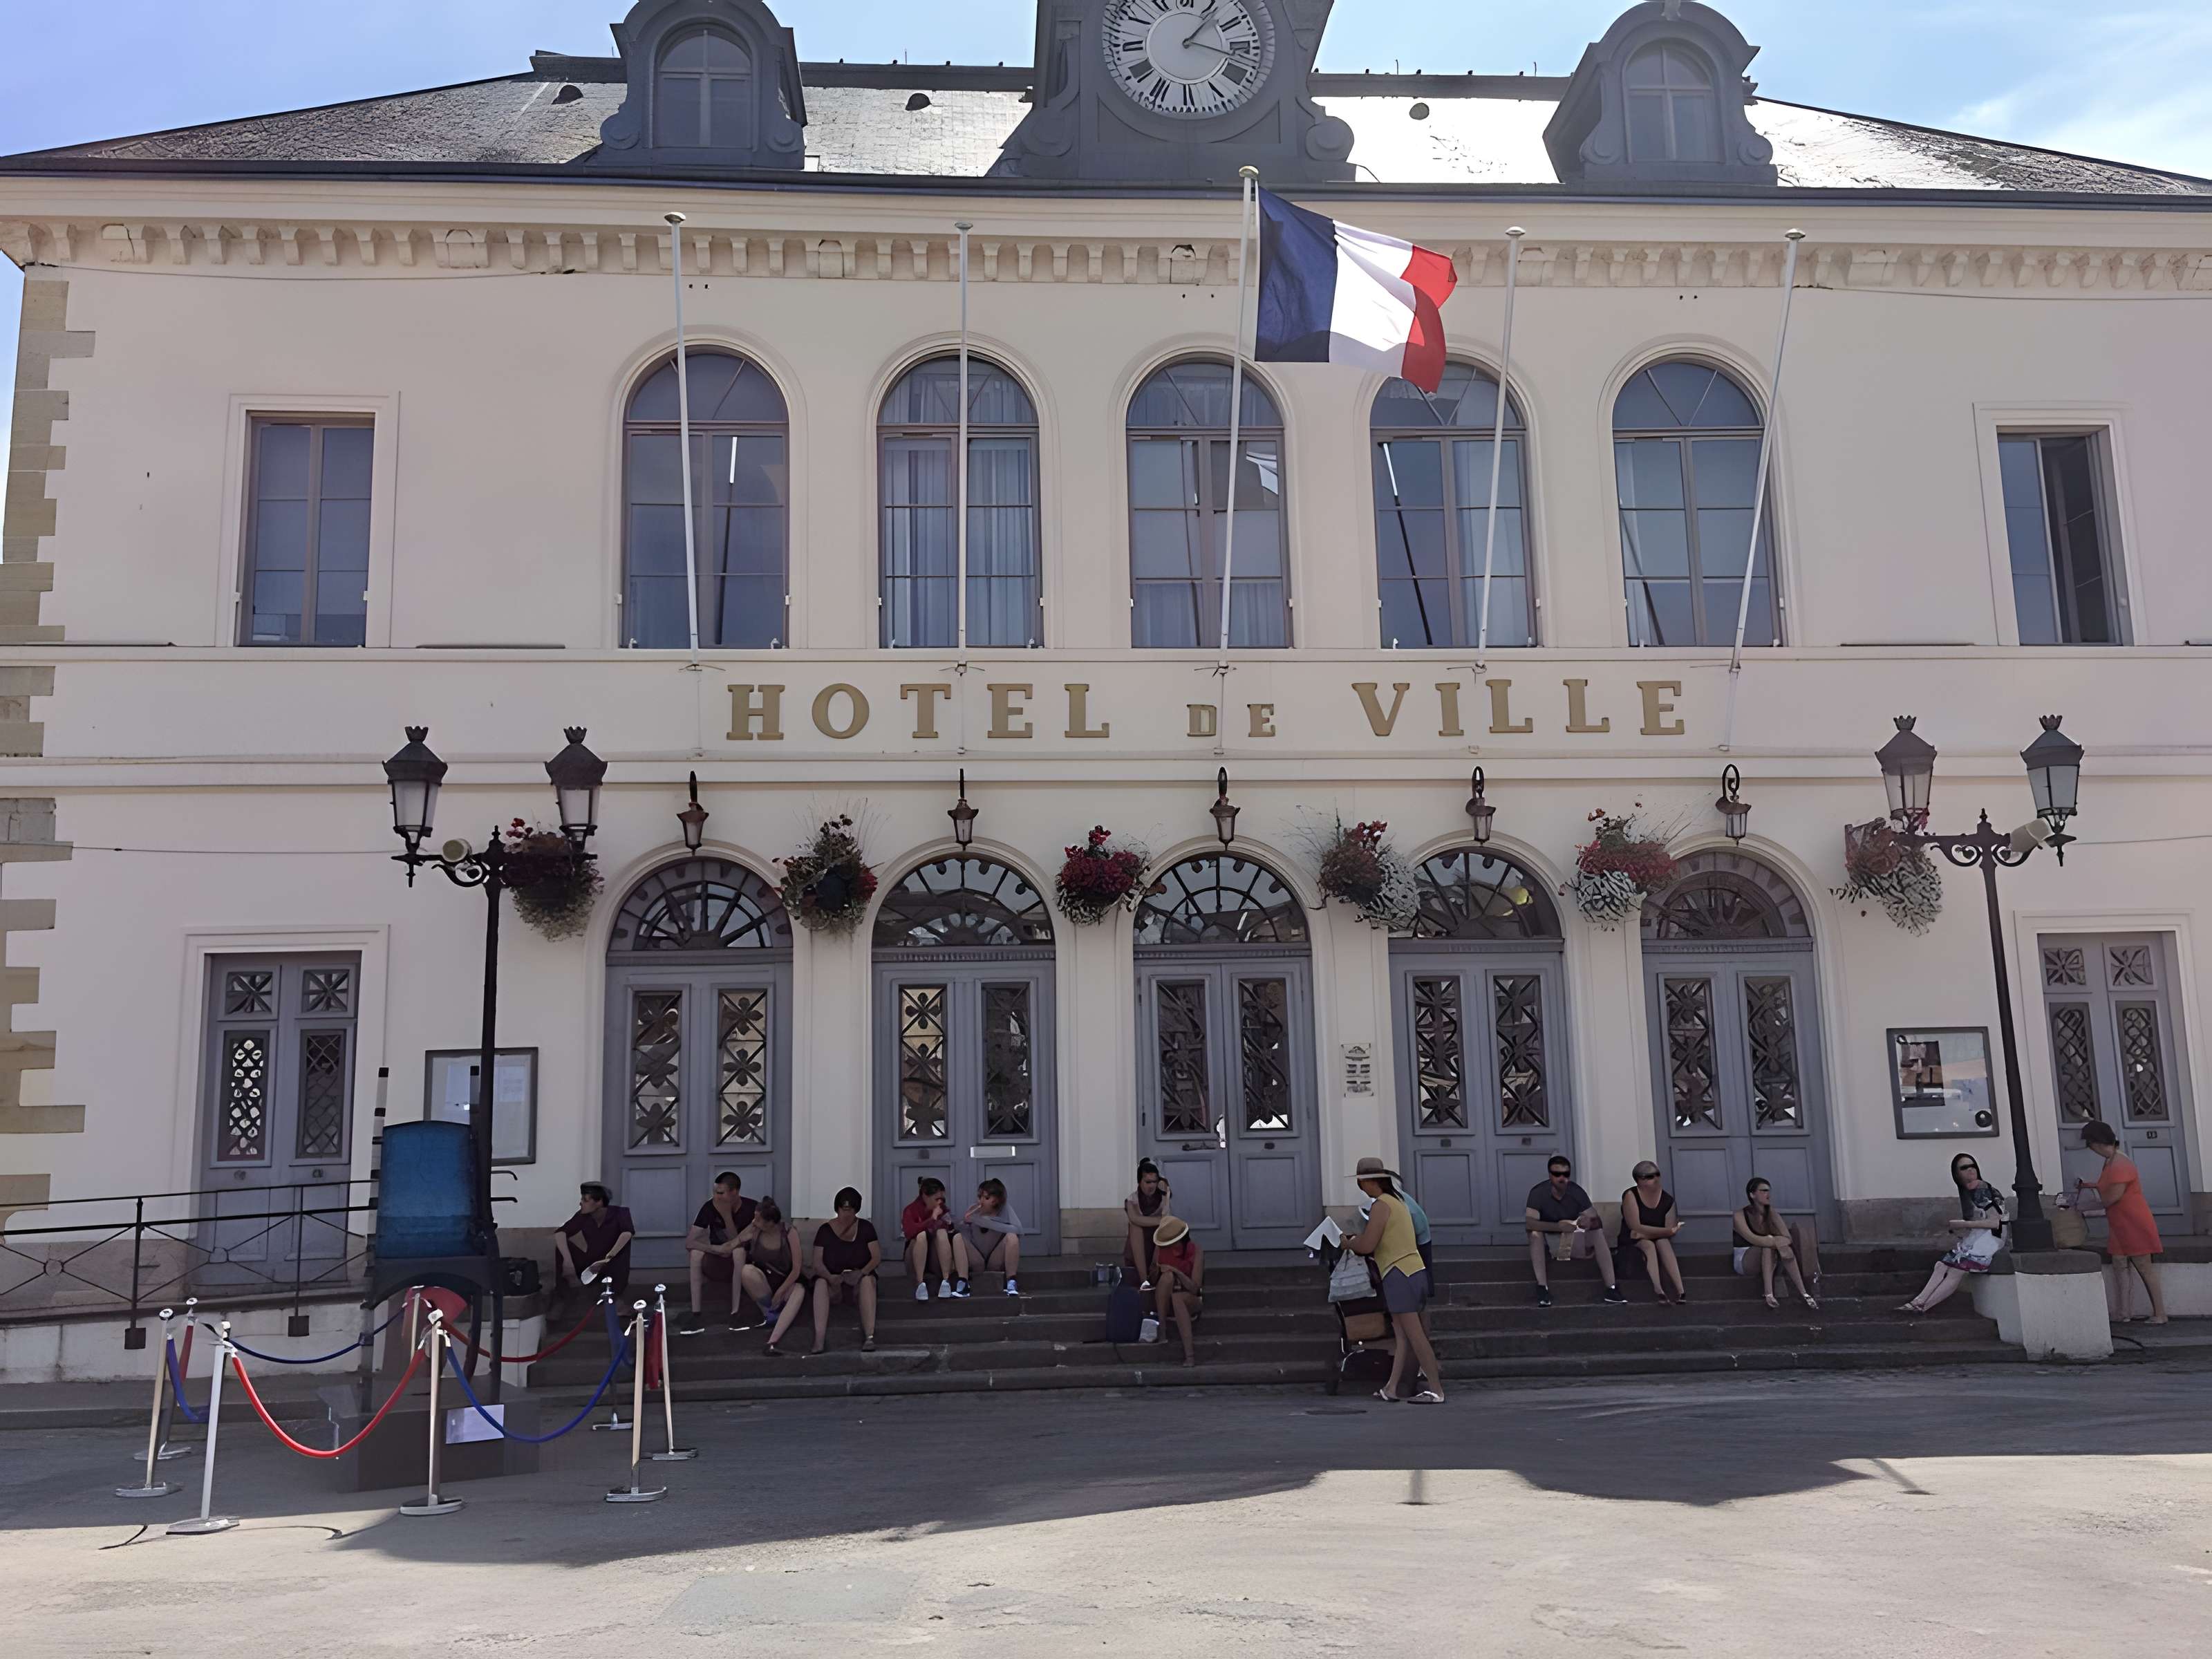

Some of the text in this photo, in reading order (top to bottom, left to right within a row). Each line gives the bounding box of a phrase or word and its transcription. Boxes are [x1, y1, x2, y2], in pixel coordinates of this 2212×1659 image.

[726, 679, 1686, 741] HOTEL DE VILLE
